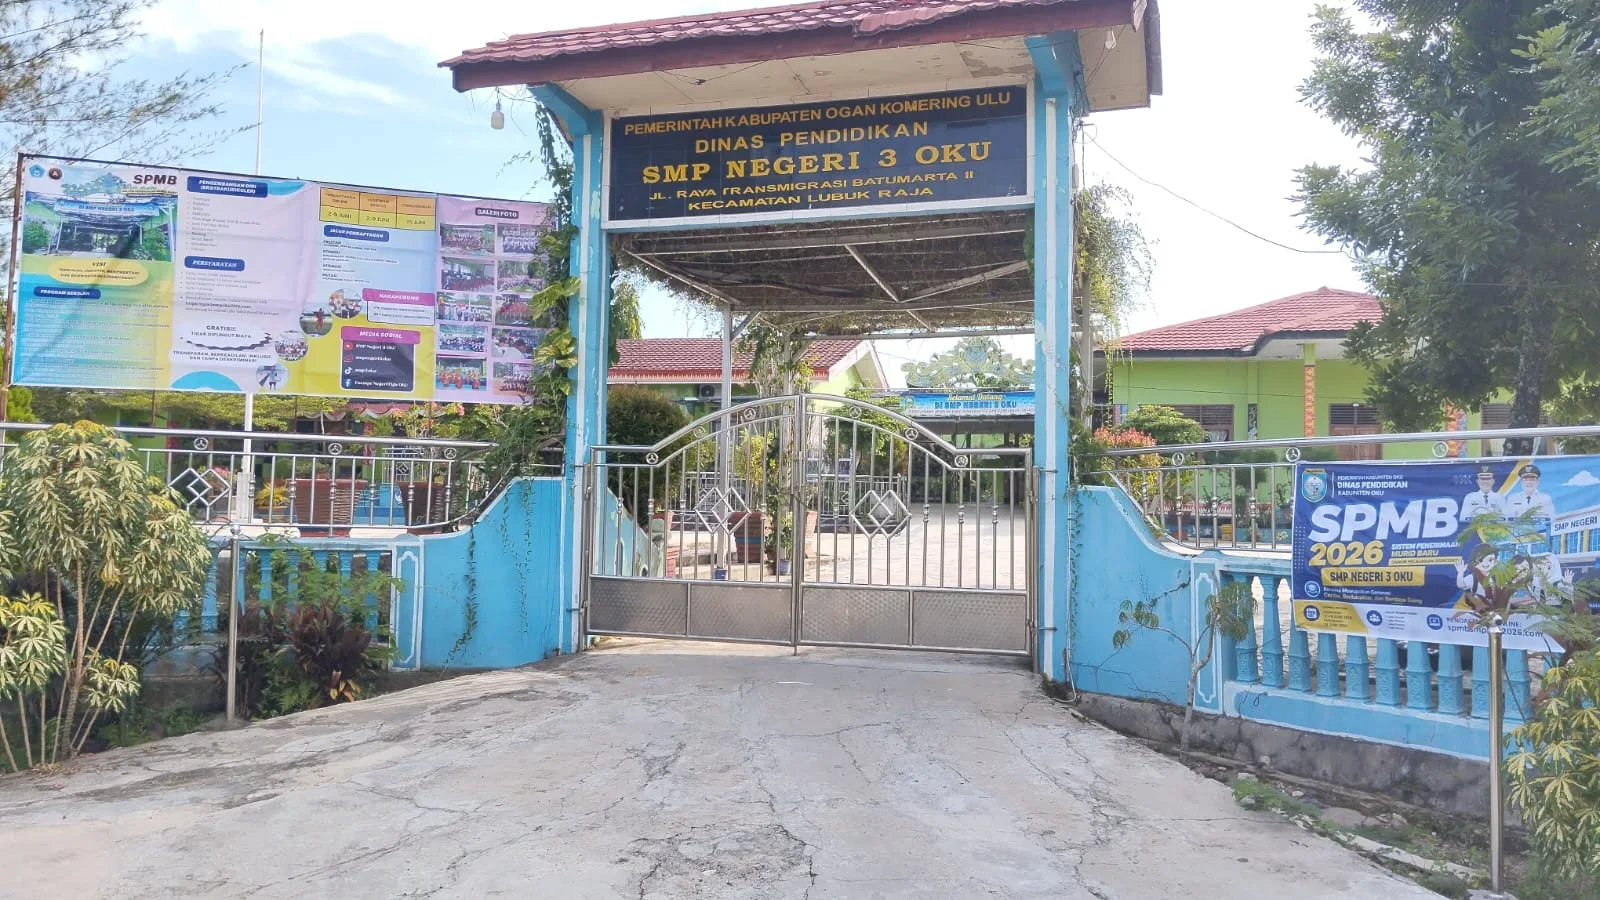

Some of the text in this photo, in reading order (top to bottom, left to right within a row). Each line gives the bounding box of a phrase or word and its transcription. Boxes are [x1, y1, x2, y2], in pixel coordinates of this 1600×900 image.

[624, 91, 1011, 136] PEMERINTAH KABUPATEN OGAN KOMERING ULU
[695, 121, 928, 154] DINAS PENDIDIKAN
[642, 141, 993, 185] SMP NEGERI 3 OKU
[132, 174, 178, 185] SPMB
[649, 170, 974, 200] JL. RAYA TRANSMIGRASI BATUMARTA II
[688, 186, 934, 211] KECAMATAN LUBUK RAJA
[1337, 481, 1361, 489] DINAS
[1308, 498, 1459, 542] SPMB
[1554, 515, 1598, 532] SMP NEGERI
[1308, 540, 1384, 566] 2026
[1329, 571, 1413, 582] SMP NEGERI 3 OKU
